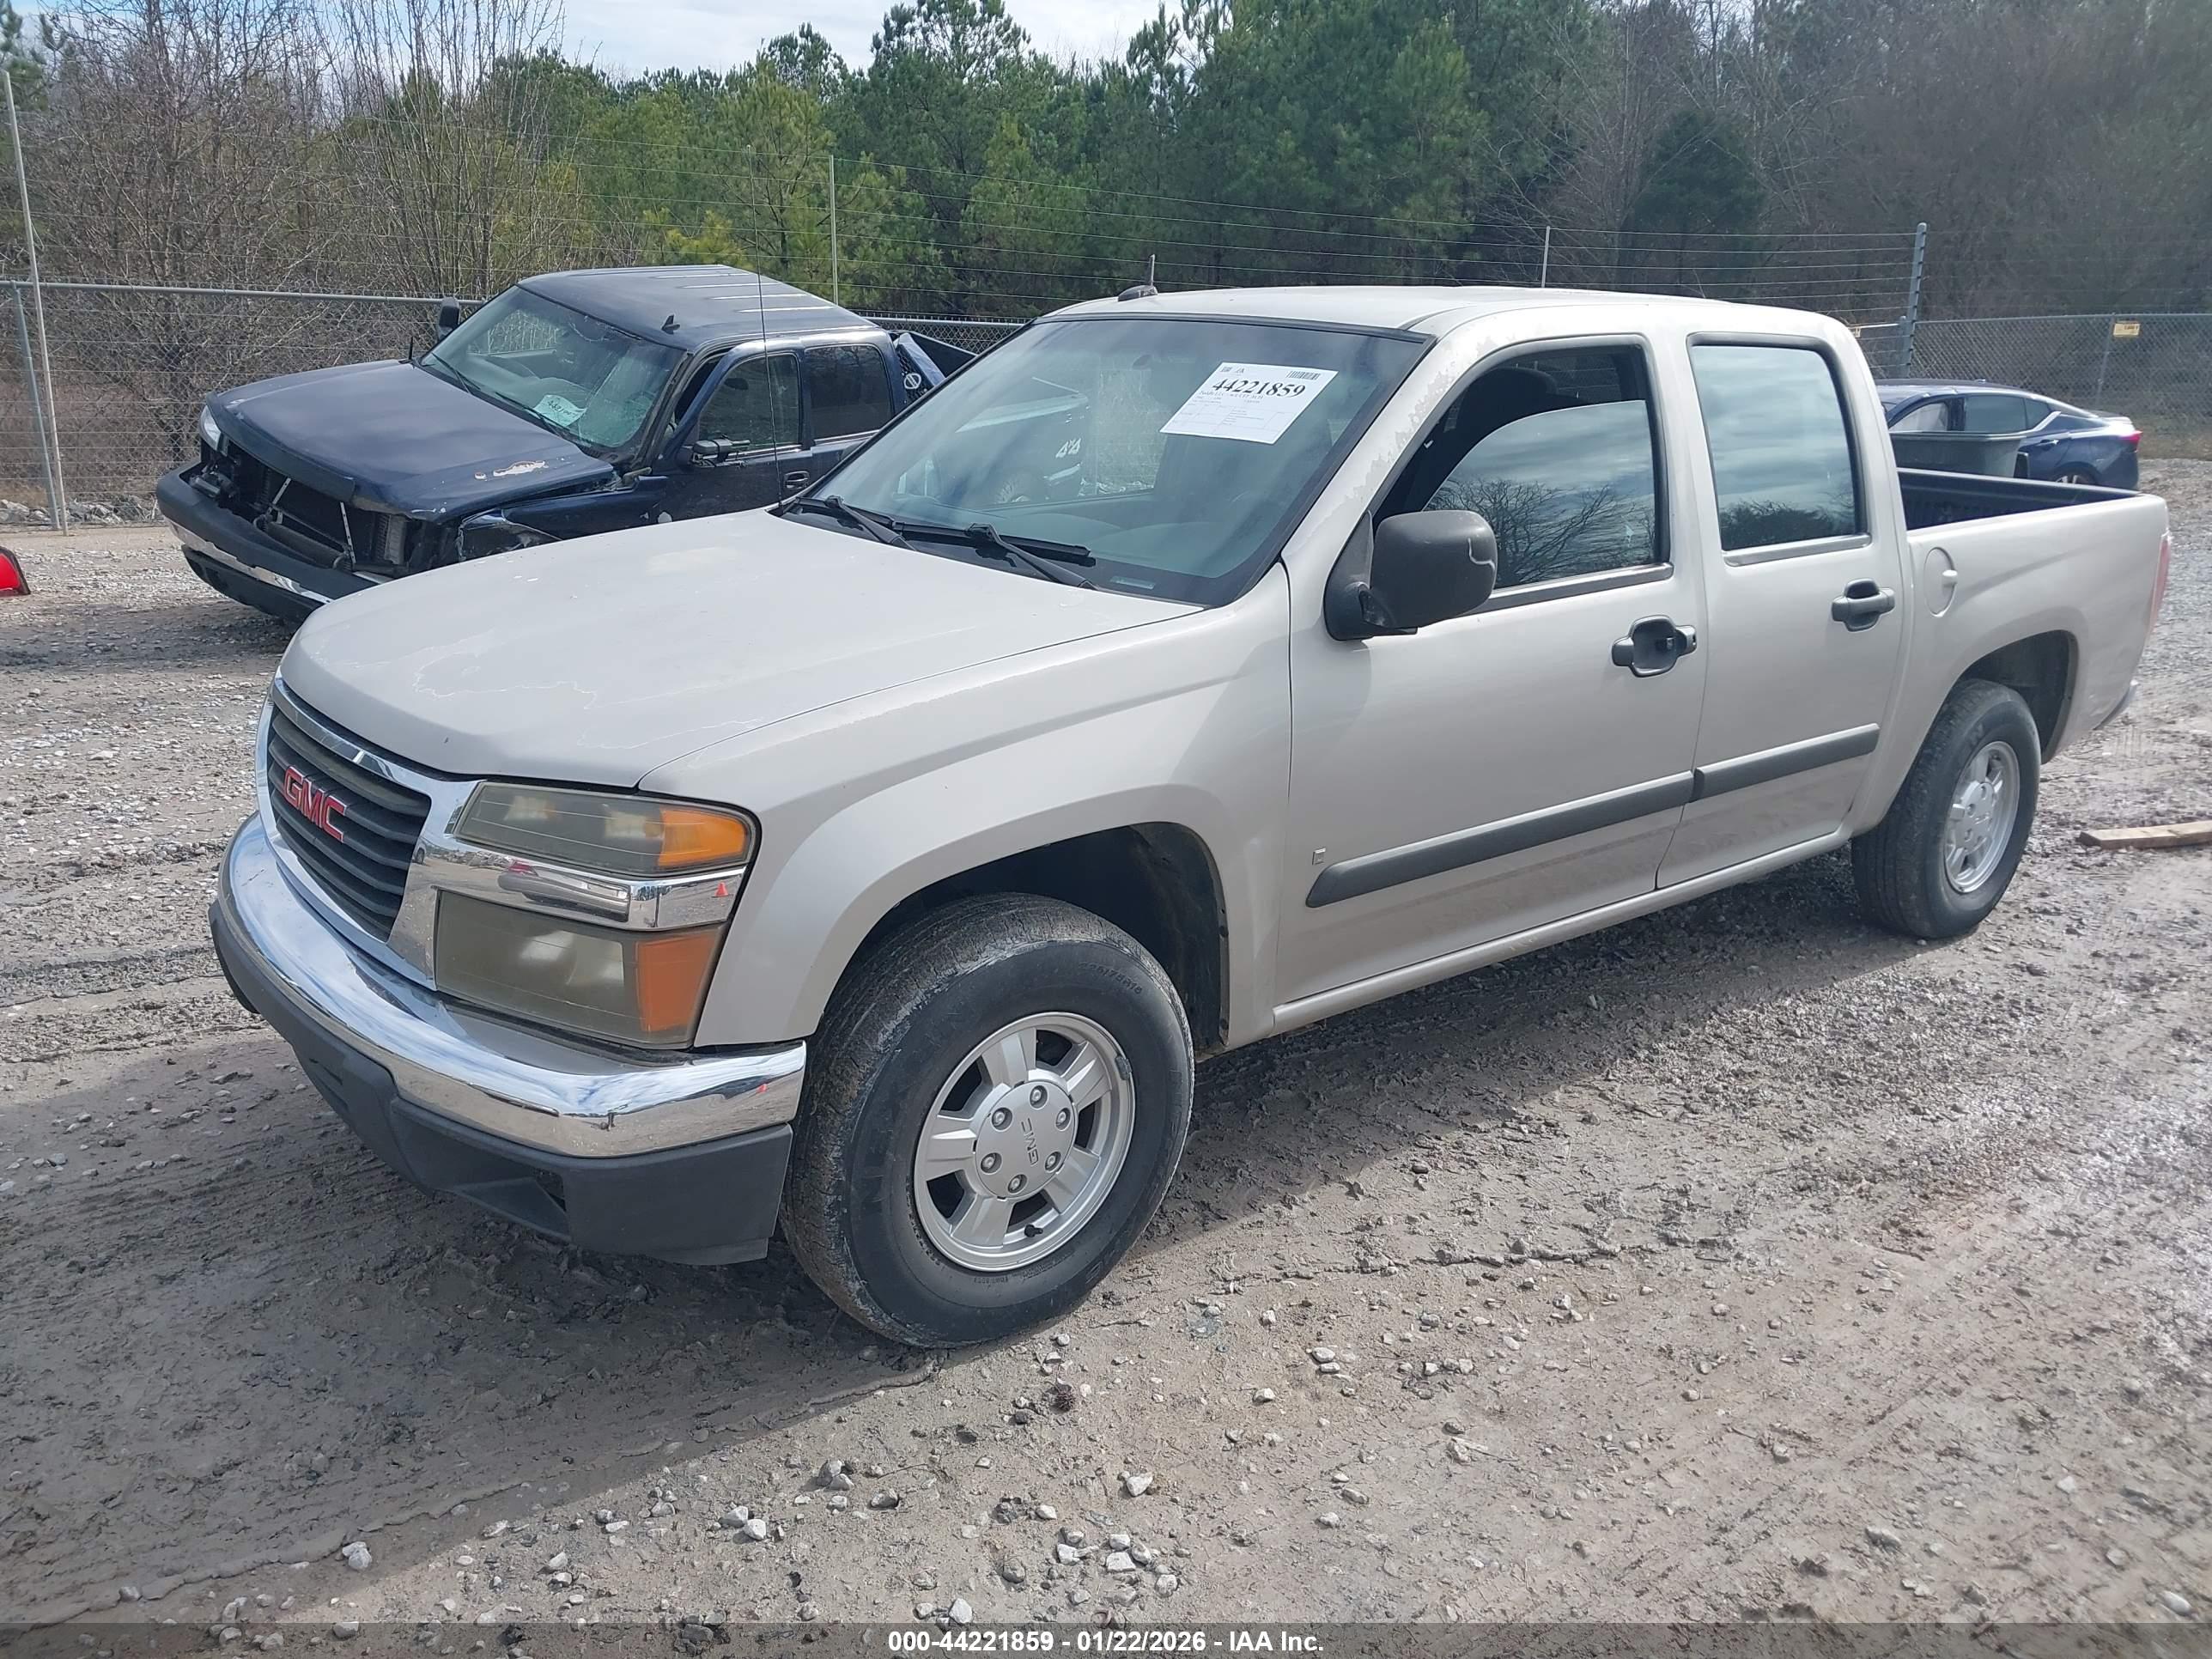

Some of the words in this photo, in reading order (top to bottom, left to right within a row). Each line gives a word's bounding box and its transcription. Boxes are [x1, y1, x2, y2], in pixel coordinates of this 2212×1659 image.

[1212, 378, 1307, 398] 44221859
[283, 765, 348, 844] GMC
[1020, 1117, 1039, 1167] GMC
